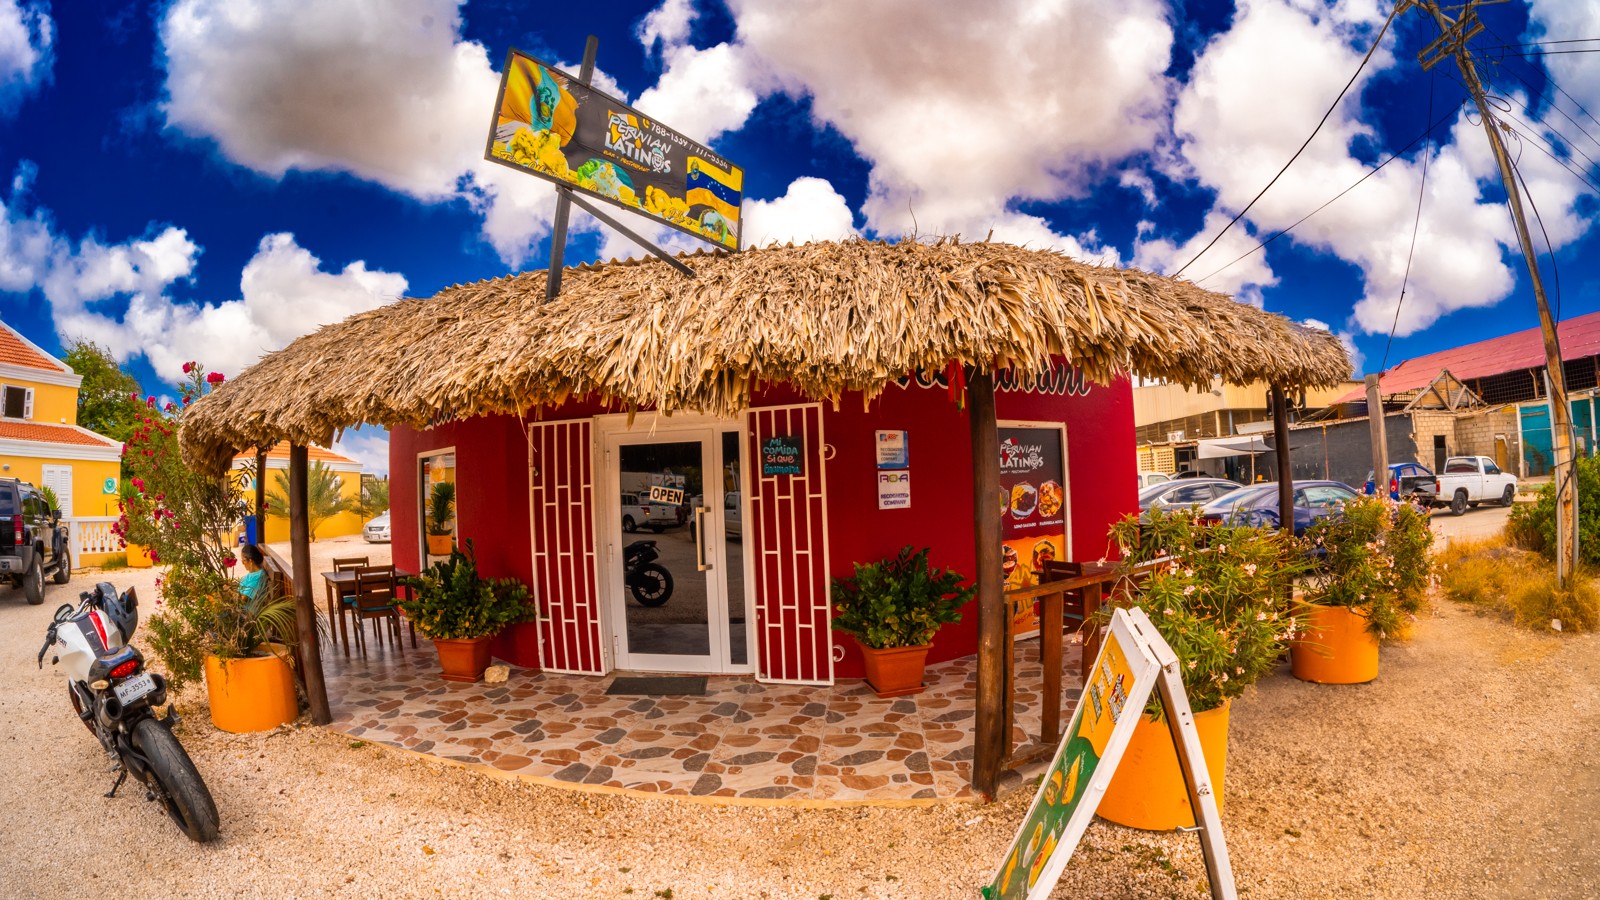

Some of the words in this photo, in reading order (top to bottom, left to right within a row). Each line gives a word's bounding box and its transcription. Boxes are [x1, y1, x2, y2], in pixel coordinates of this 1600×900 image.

[604, 131, 672, 174] LATINOS
[999, 456, 1044, 469] LATINOS
[652, 487, 682, 504] OPEN
[119, 680, 147, 698] MF-3553
